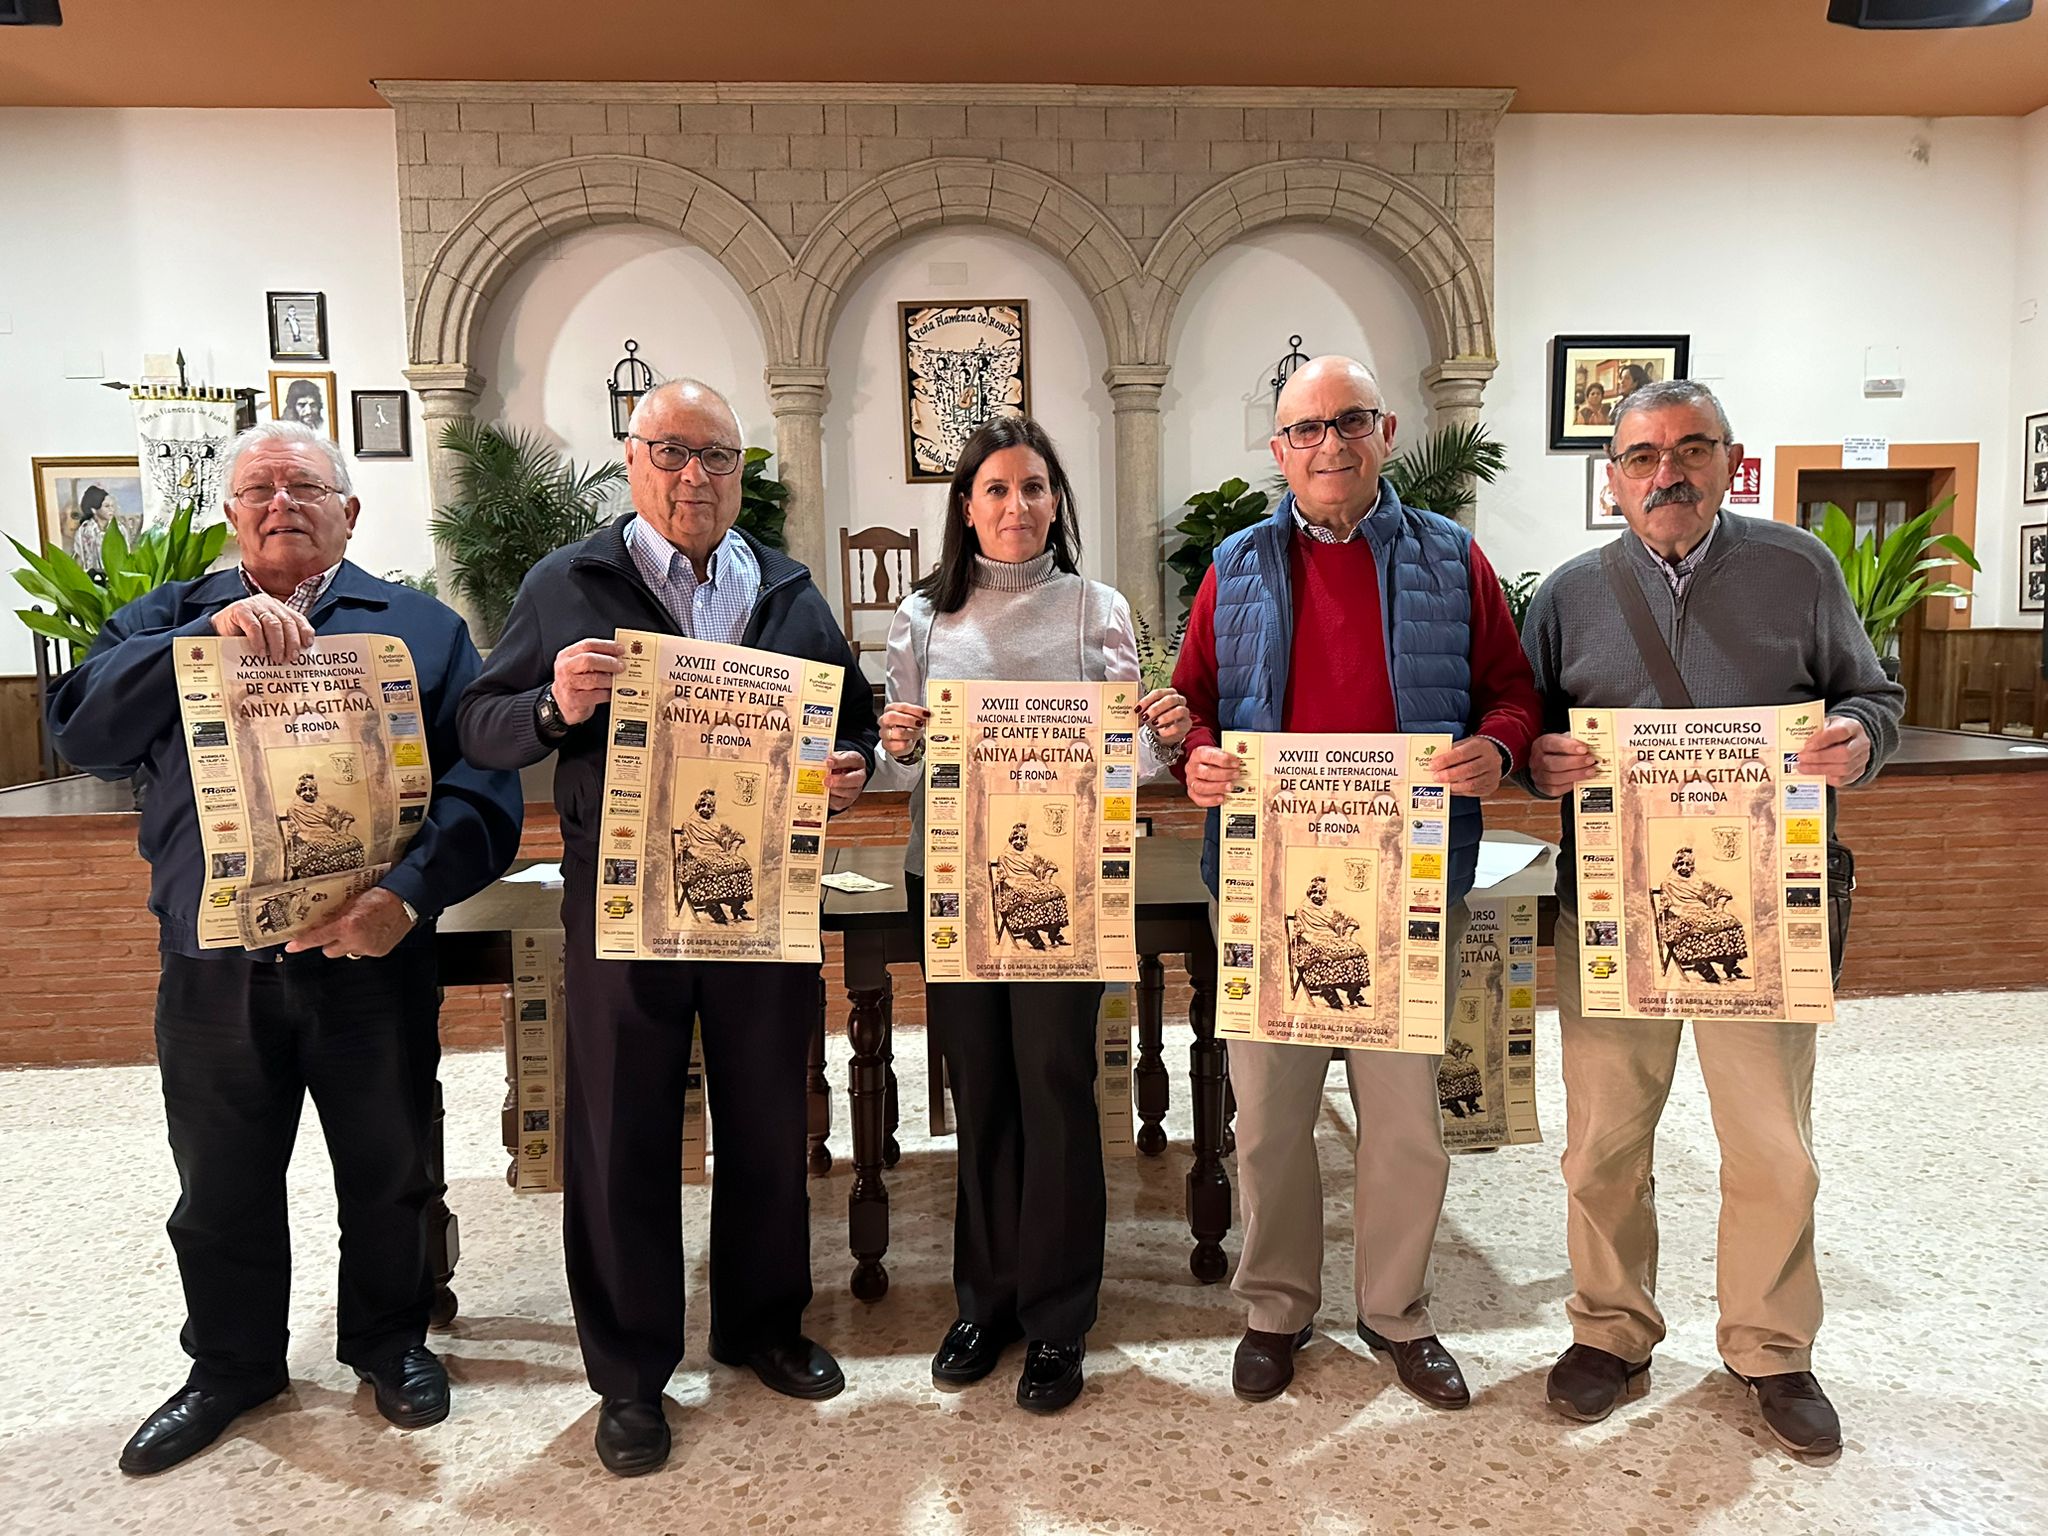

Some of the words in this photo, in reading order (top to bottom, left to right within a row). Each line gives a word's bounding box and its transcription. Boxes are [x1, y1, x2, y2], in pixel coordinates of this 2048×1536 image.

[913, 323, 935, 338] Peña
[935, 313, 976, 327] Flamenca
[977, 313, 986, 324] de
[989, 317, 1015, 337] Ronda
[240, 655, 282, 667] XXVI
[675, 655, 716, 671] XXVIII
[723, 661, 789, 680] CONCURSO
[237, 671, 284, 680] NACIONAL
[293, 667, 366, 678] INTERNACIONAL
[247, 683, 264, 694] DE
[267, 682, 308, 694] CANTE
[311, 681, 321, 692] Y
[324, 678, 361, 691] BAILE
[669, 671, 714, 684] NACIONAL
[716, 676, 721, 684] E
[723, 677, 793, 693] INTERNACIONAL
[675, 685, 691, 698] DE
[694, 687, 733, 701] CANTE
[738, 691, 746, 702] Y
[749, 692, 784, 707] BAILE
[240, 701, 290, 718] ANIYA
[294, 700, 312, 715] LA
[316, 698, 374, 713] GITANA
[982, 698, 1019, 711] XXVIII
[1025, 699, 1088, 711] CONCURSO
[663, 706, 710, 725] ANIYA
[714, 711, 731, 726] LA
[735, 713, 791, 731] GITANA
[977, 715, 1018, 723] NACIONAL
[1020, 715, 1025, 723] E
[1027, 715, 1092, 724] INTERNACIONAL
[285, 723, 299, 733] DE
[302, 721, 339, 732] RONDA
[983, 727, 998, 738] DE
[1001, 727, 1039, 739] CANTE
[1042, 728, 1050, 738] Y
[1053, 728, 1086, 739] BAILE
[1634, 724, 1676, 735] XXVIII
[1685, 723, 1761, 734] CONCURSO
[700, 734, 714, 744] DE
[716, 735, 751, 747] RONDA
[1629, 738, 1677, 747] NACIONAL
[1679, 738, 1685, 746] E
[1688, 736, 1767, 746] INTERNACIONAL
[973, 748, 1018, 762] ANIYA
[1022, 749, 1037, 762] LA
[1041, 749, 1094, 762] GITANA
[1279, 750, 1318, 762] XXVIII
[1326, 751, 1394, 763] CONCURSO
[1637, 750, 1655, 761] DE
[1658, 749, 1702, 760] CANTE
[1705, 749, 1715, 760] Y
[1719, 748, 1759, 759] BAILE
[1010, 771, 1023, 780] DE
[1025, 771, 1058, 780] RONDA
[1274, 767, 1318, 775] NACIONAL
[1320, 767, 1325, 775] E
[1327, 768, 1398, 776] INTERNACIONAL
[1628, 769, 1679, 784] ANIYA
[1684, 769, 1701, 783] LA
[1705, 767, 1771, 783] GITANA
[1280, 779, 1296, 790] DE
[1300, 779, 1339, 791] CANTE
[1343, 780, 1351, 791] Y
[1355, 780, 1390, 792] BAILE
[1670, 792, 1685, 802] DE
[1688, 791, 1728, 802] RONDA
[1271, 800, 1317, 814] ANIYA
[1321, 801, 1338, 814] LA
[1342, 801, 1400, 816] GITANA
[1308, 823, 1322, 832] DE
[1324, 823, 1360, 833] RONDA
[1466, 934, 1494, 944] BAILE
[1374, 1026, 1388, 1035] 2024
